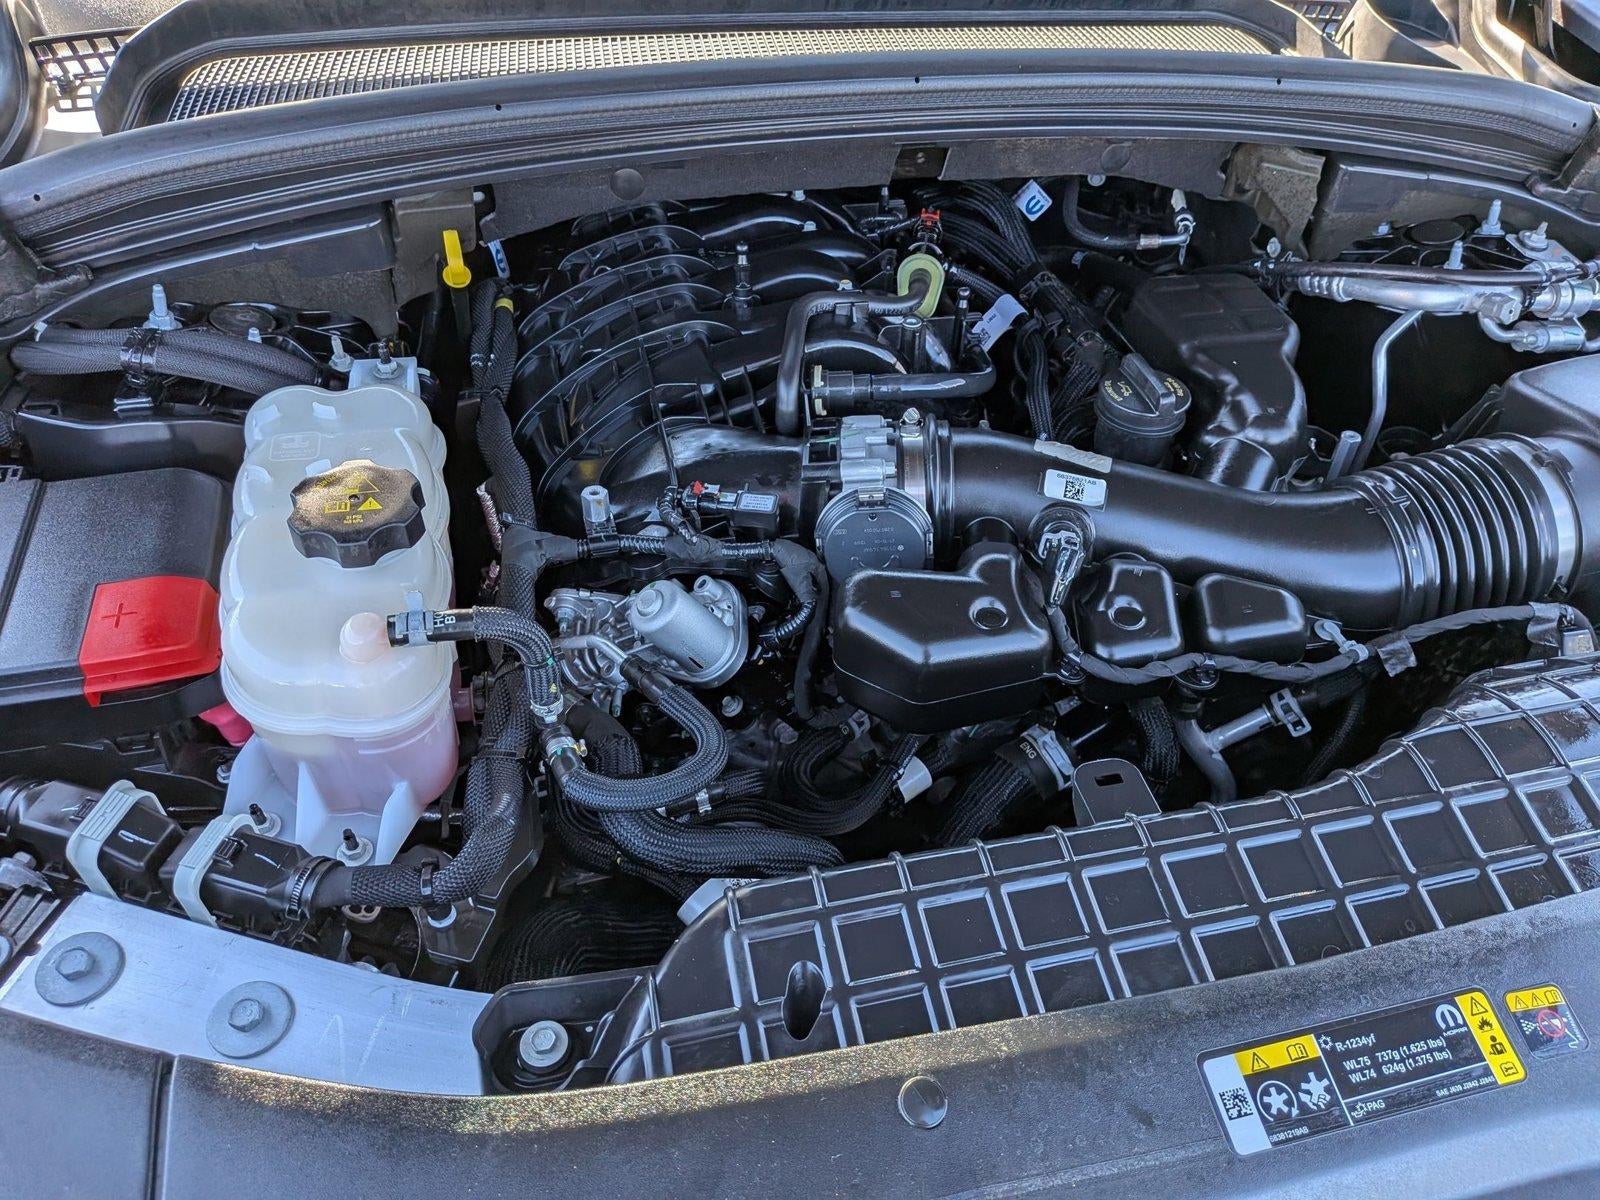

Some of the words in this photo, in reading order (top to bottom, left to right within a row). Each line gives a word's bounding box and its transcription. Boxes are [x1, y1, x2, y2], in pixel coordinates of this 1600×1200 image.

[1020, 741, 1037, 759] ENG
[1335, 1033, 1377, 1052] R-1234yf
[1343, 1055, 1371, 1071] WL75
[1375, 1049, 1400, 1063] 737g
[1400, 1041, 1427, 1058] (1.625
[1426, 1036, 1446, 1049] lbs)
[1348, 1069, 1377, 1084] WL74
[1381, 1061, 1406, 1075] 624g
[1405, 1054, 1433, 1071] (1.375
[1433, 1049, 1453, 1062] lbs)
[1435, 1088, 1449, 1097] SAE
[1367, 1099, 1386, 1111] PAG
